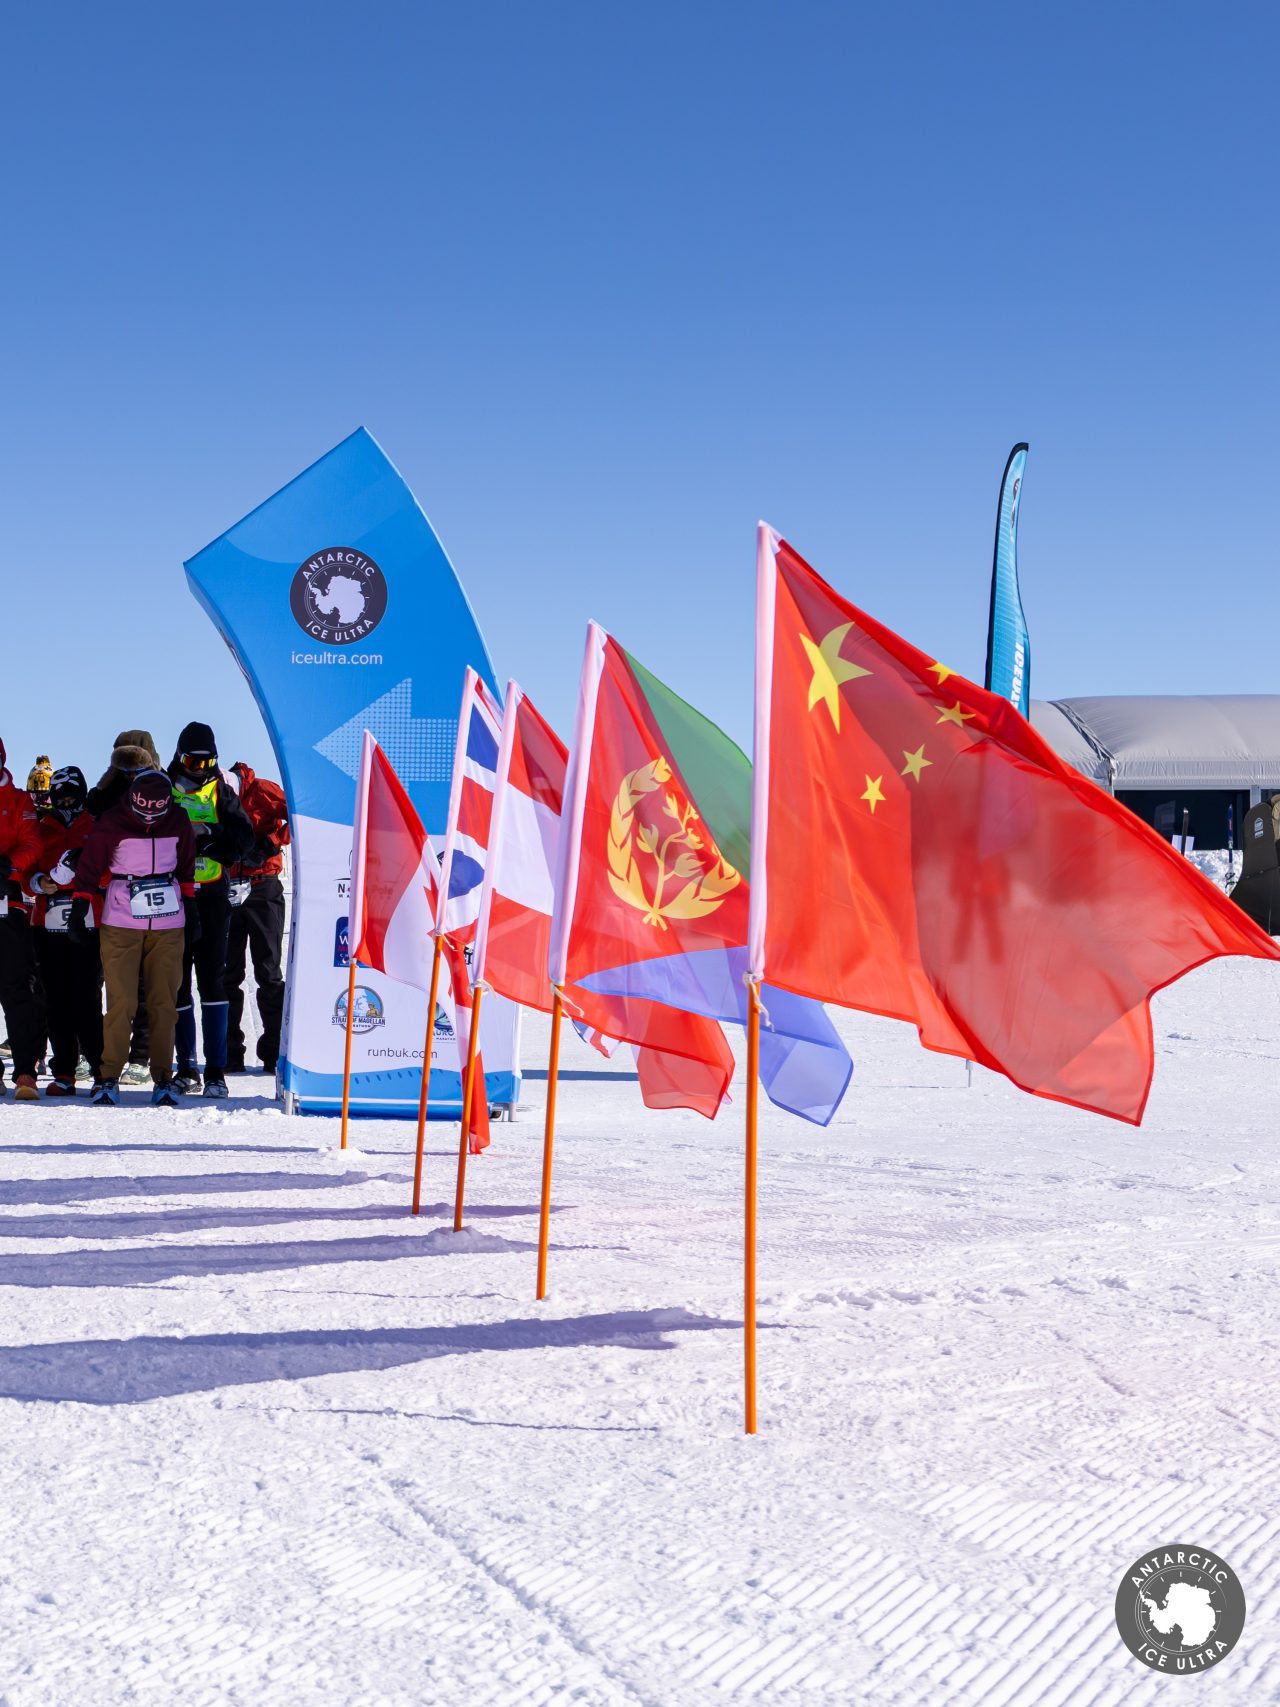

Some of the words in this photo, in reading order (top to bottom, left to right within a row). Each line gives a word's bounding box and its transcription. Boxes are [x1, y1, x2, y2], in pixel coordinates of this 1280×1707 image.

[302, 552, 375, 580] ANTARCTIC
[306, 620, 328, 639] ICE
[335, 619, 373, 641] ULTRA
[291, 651, 383, 665] iceultra.com
[144, 891, 165, 907] 15
